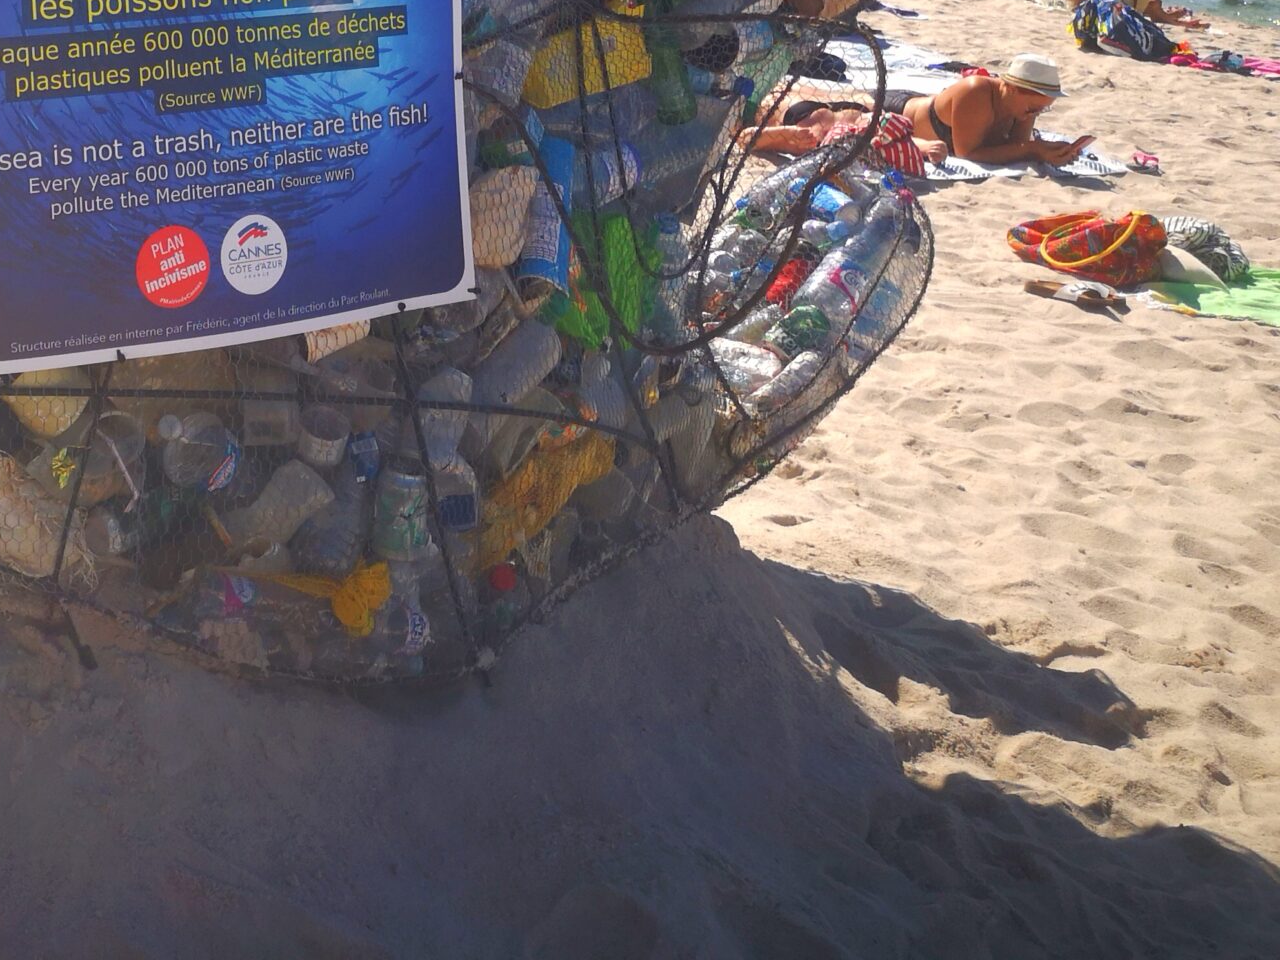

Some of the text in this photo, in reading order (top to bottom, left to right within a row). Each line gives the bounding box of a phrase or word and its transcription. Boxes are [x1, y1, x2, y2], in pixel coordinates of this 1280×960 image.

[66, 32, 136, 59] année
[143, 29, 183, 52] 600
[190, 25, 229, 48] 000
[235, 23, 302, 44] tonnes
[307, 16, 331, 37] de
[335, 11, 406, 35] déchets
[14, 39, 375, 98] plastiques polluent la Méditerranée
[158, 83, 262, 111] (Source WWF)
[52, 143, 73, 166] is
[82, 138, 123, 163] not
[131, 139, 145, 158] a
[153, 127, 221, 155] trash,
[230, 119, 306, 147] neither
[312, 117, 345, 137] are
[350, 109, 383, 132] the
[387, 102, 427, 127] fish!
[28, 140, 369, 194] Every year 600 000 tons of plastic waste
[50, 166, 355, 220] pollute the Mediterranean (Source WWF)
[151, 233, 184, 257] PLAN
[159, 249, 186, 271] anti
[228, 242, 281, 261] CANNES
[144, 260, 206, 293] incivisme
[10, 339, 61, 353] Structure
[64, 332, 105, 348] réalisée
[108, 331, 122, 342] en
[125, 327, 163, 339] interne
[165, 324, 182, 337] par
[186, 317, 230, 332] Frédéric,
[232, 311, 259, 327] agent
[263, 307, 275, 320] de
[277, 306, 285, 318] la
[287, 301, 326, 316] direction
[327, 296, 339, 309] du
[340, 291, 360, 306] Parc
